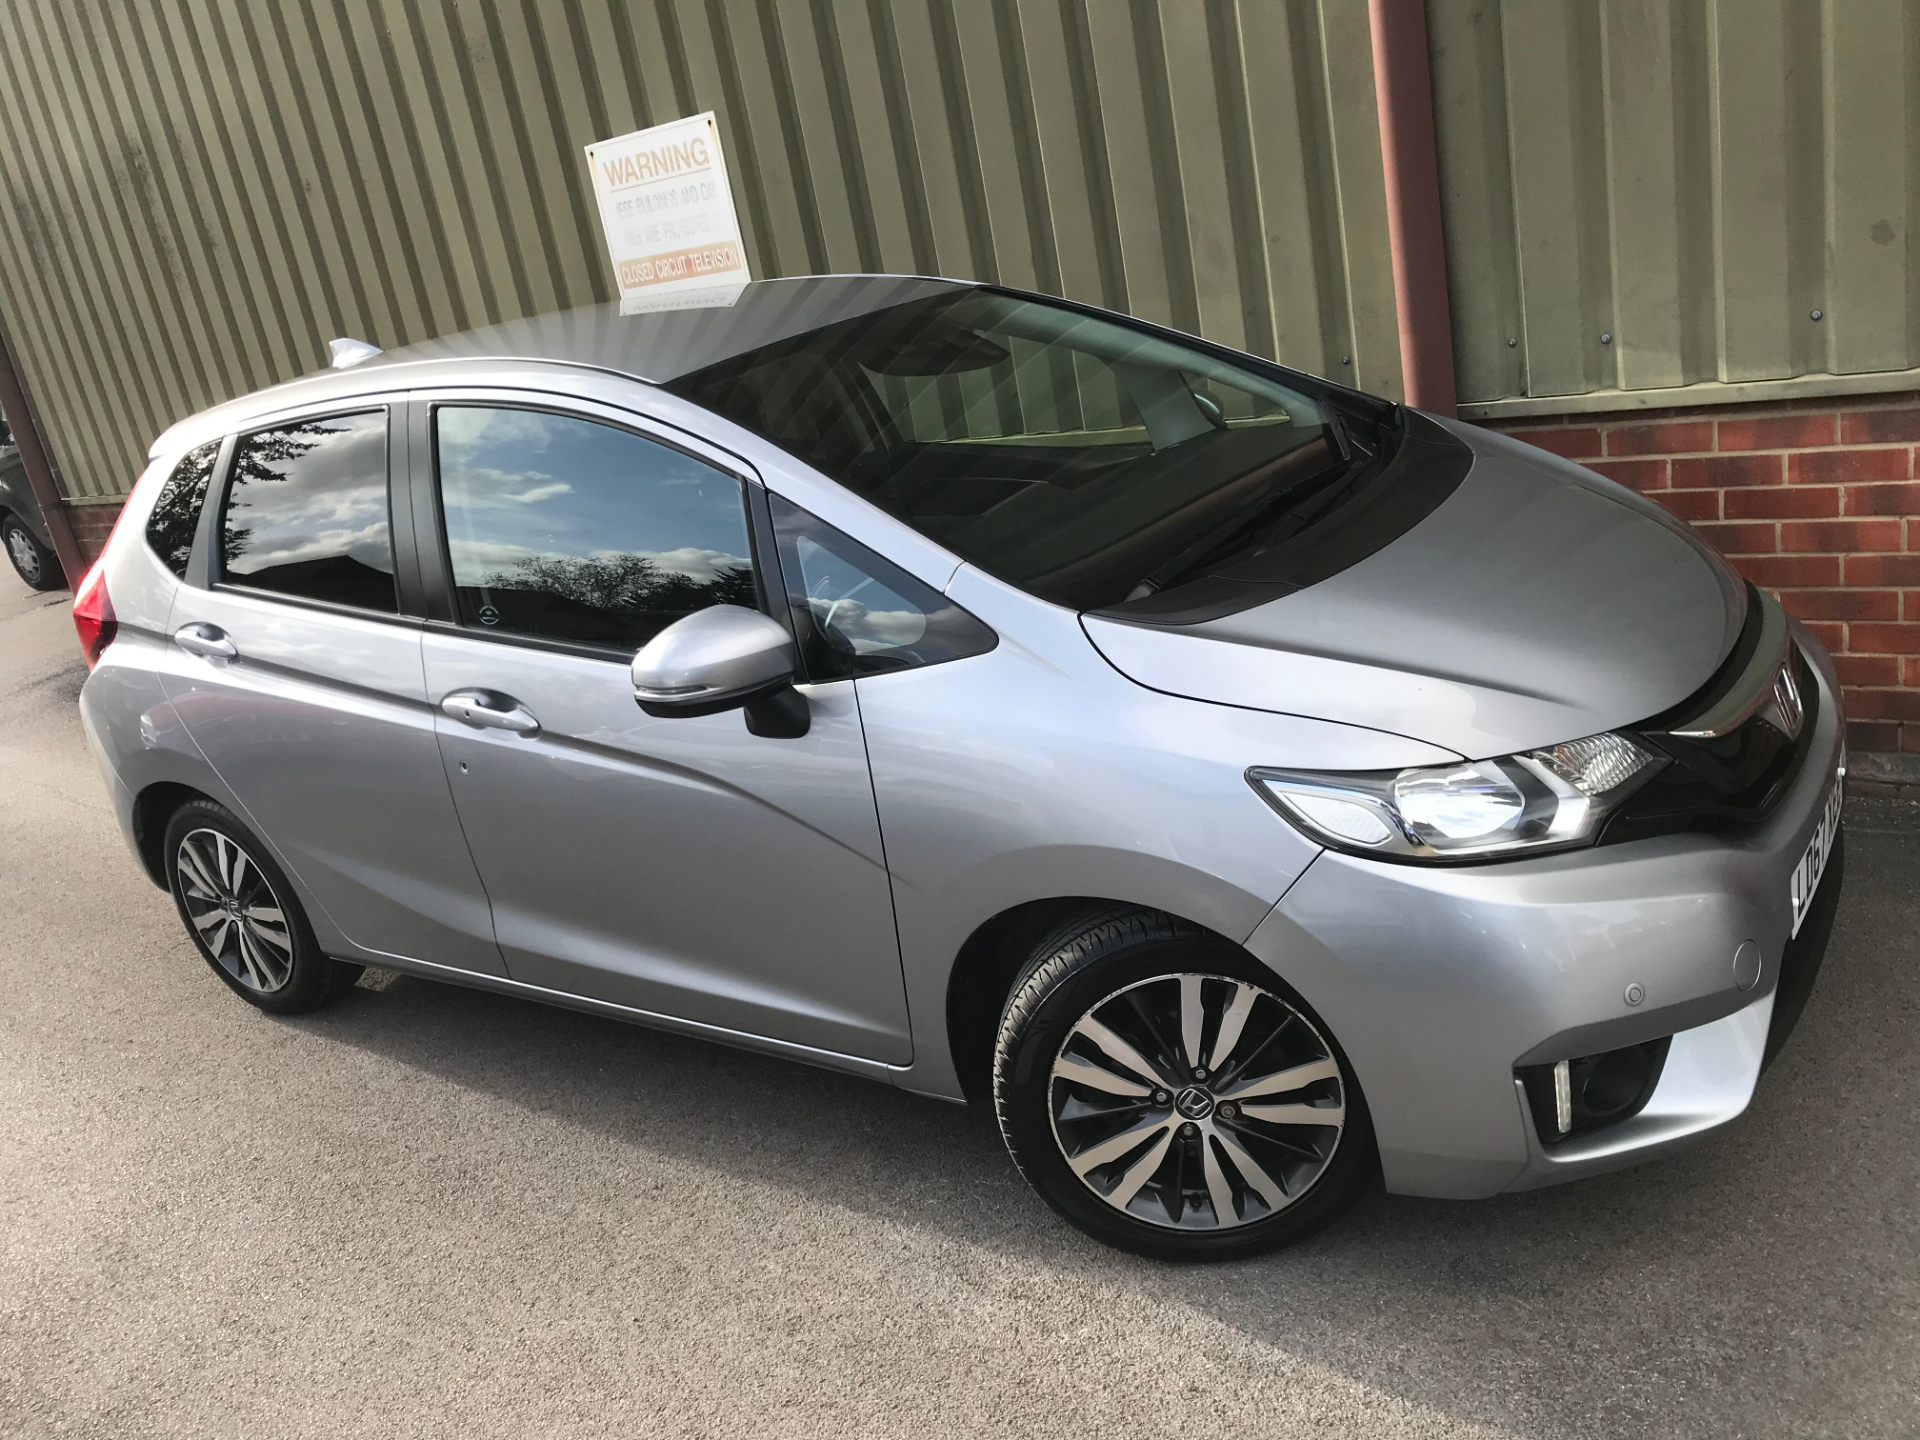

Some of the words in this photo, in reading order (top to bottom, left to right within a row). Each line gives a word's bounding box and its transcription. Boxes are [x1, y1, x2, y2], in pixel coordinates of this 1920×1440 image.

[603, 137, 710, 187] WARNING
[635, 188, 680, 216] BUILDINGS
[680, 184, 699, 206] AND
[644, 223, 662, 244] ARE
[621, 262, 655, 285] CLOSED
[655, 255, 688, 279] CIRCUIT
[688, 246, 740, 273] TELEVISION
